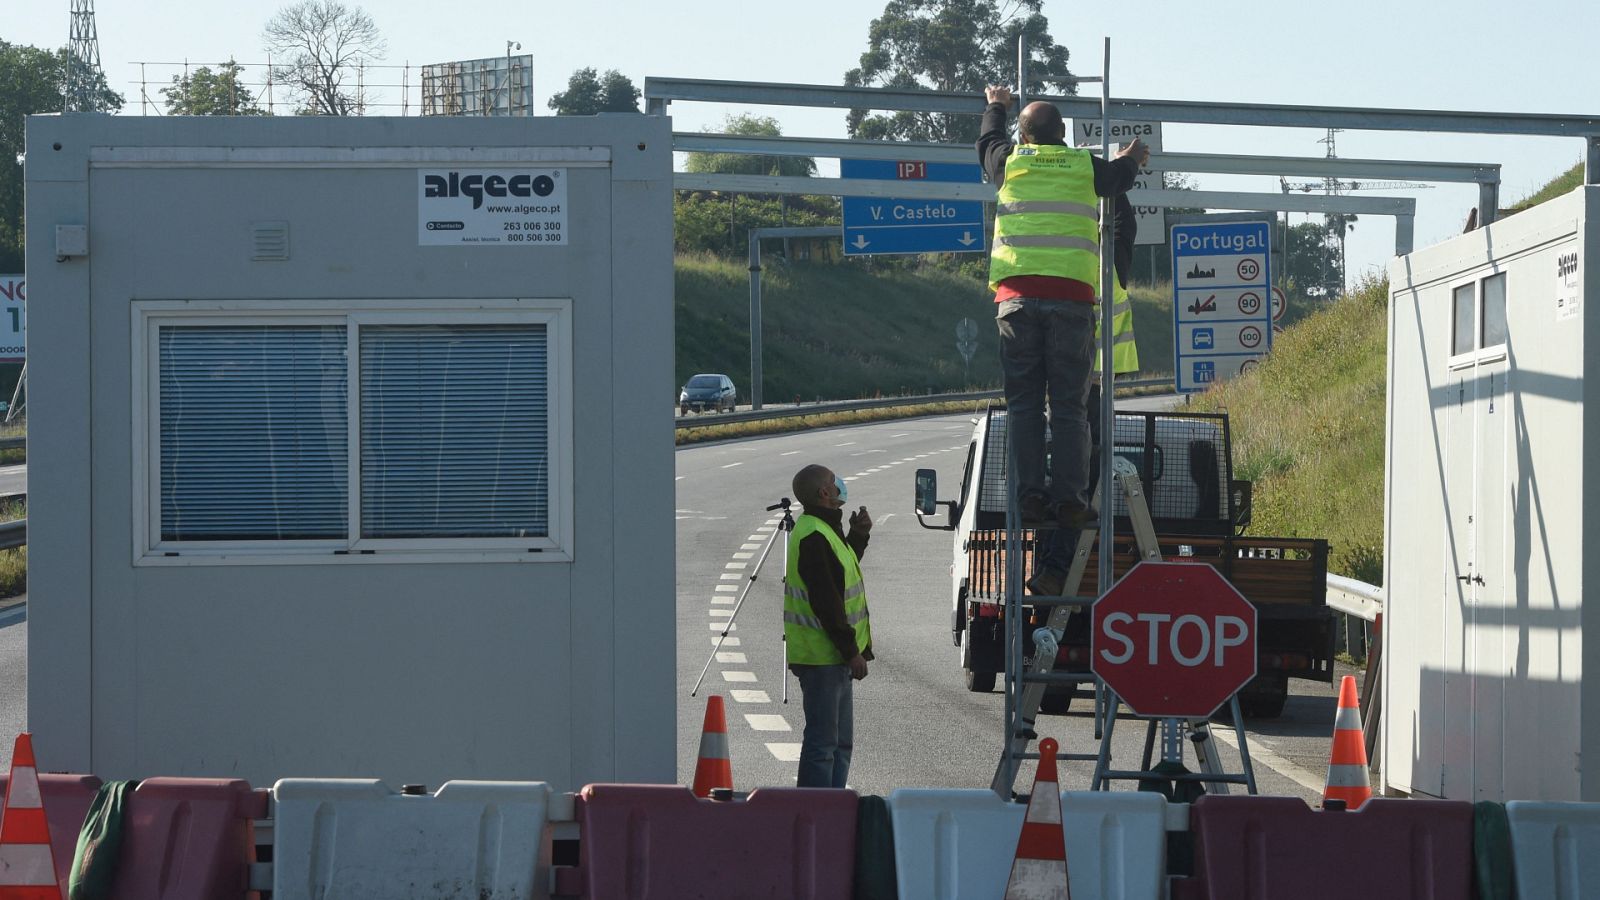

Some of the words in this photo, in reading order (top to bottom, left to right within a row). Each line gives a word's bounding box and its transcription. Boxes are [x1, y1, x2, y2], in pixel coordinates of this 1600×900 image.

[1082, 123, 1153, 139] Vaença
[899, 162, 925, 178] IP1
[487, 204, 561, 215] www.algeco.pt
[870, 206, 884, 220] V.
[893, 204, 956, 220] Castelo
[503, 222, 521, 231] 263
[524, 222, 541, 231] 006
[544, 222, 561, 231] 300
[507, 233, 524, 242] 800
[526, 233, 543, 242] 506
[545, 233, 561, 242] 300
[1176, 230, 1265, 251] Portugal
[1241, 265, 1256, 275] 50
[1242, 299, 1257, 308] 90
[1243, 333, 1258, 341] 100
[1100, 611, 1249, 667] STOP
